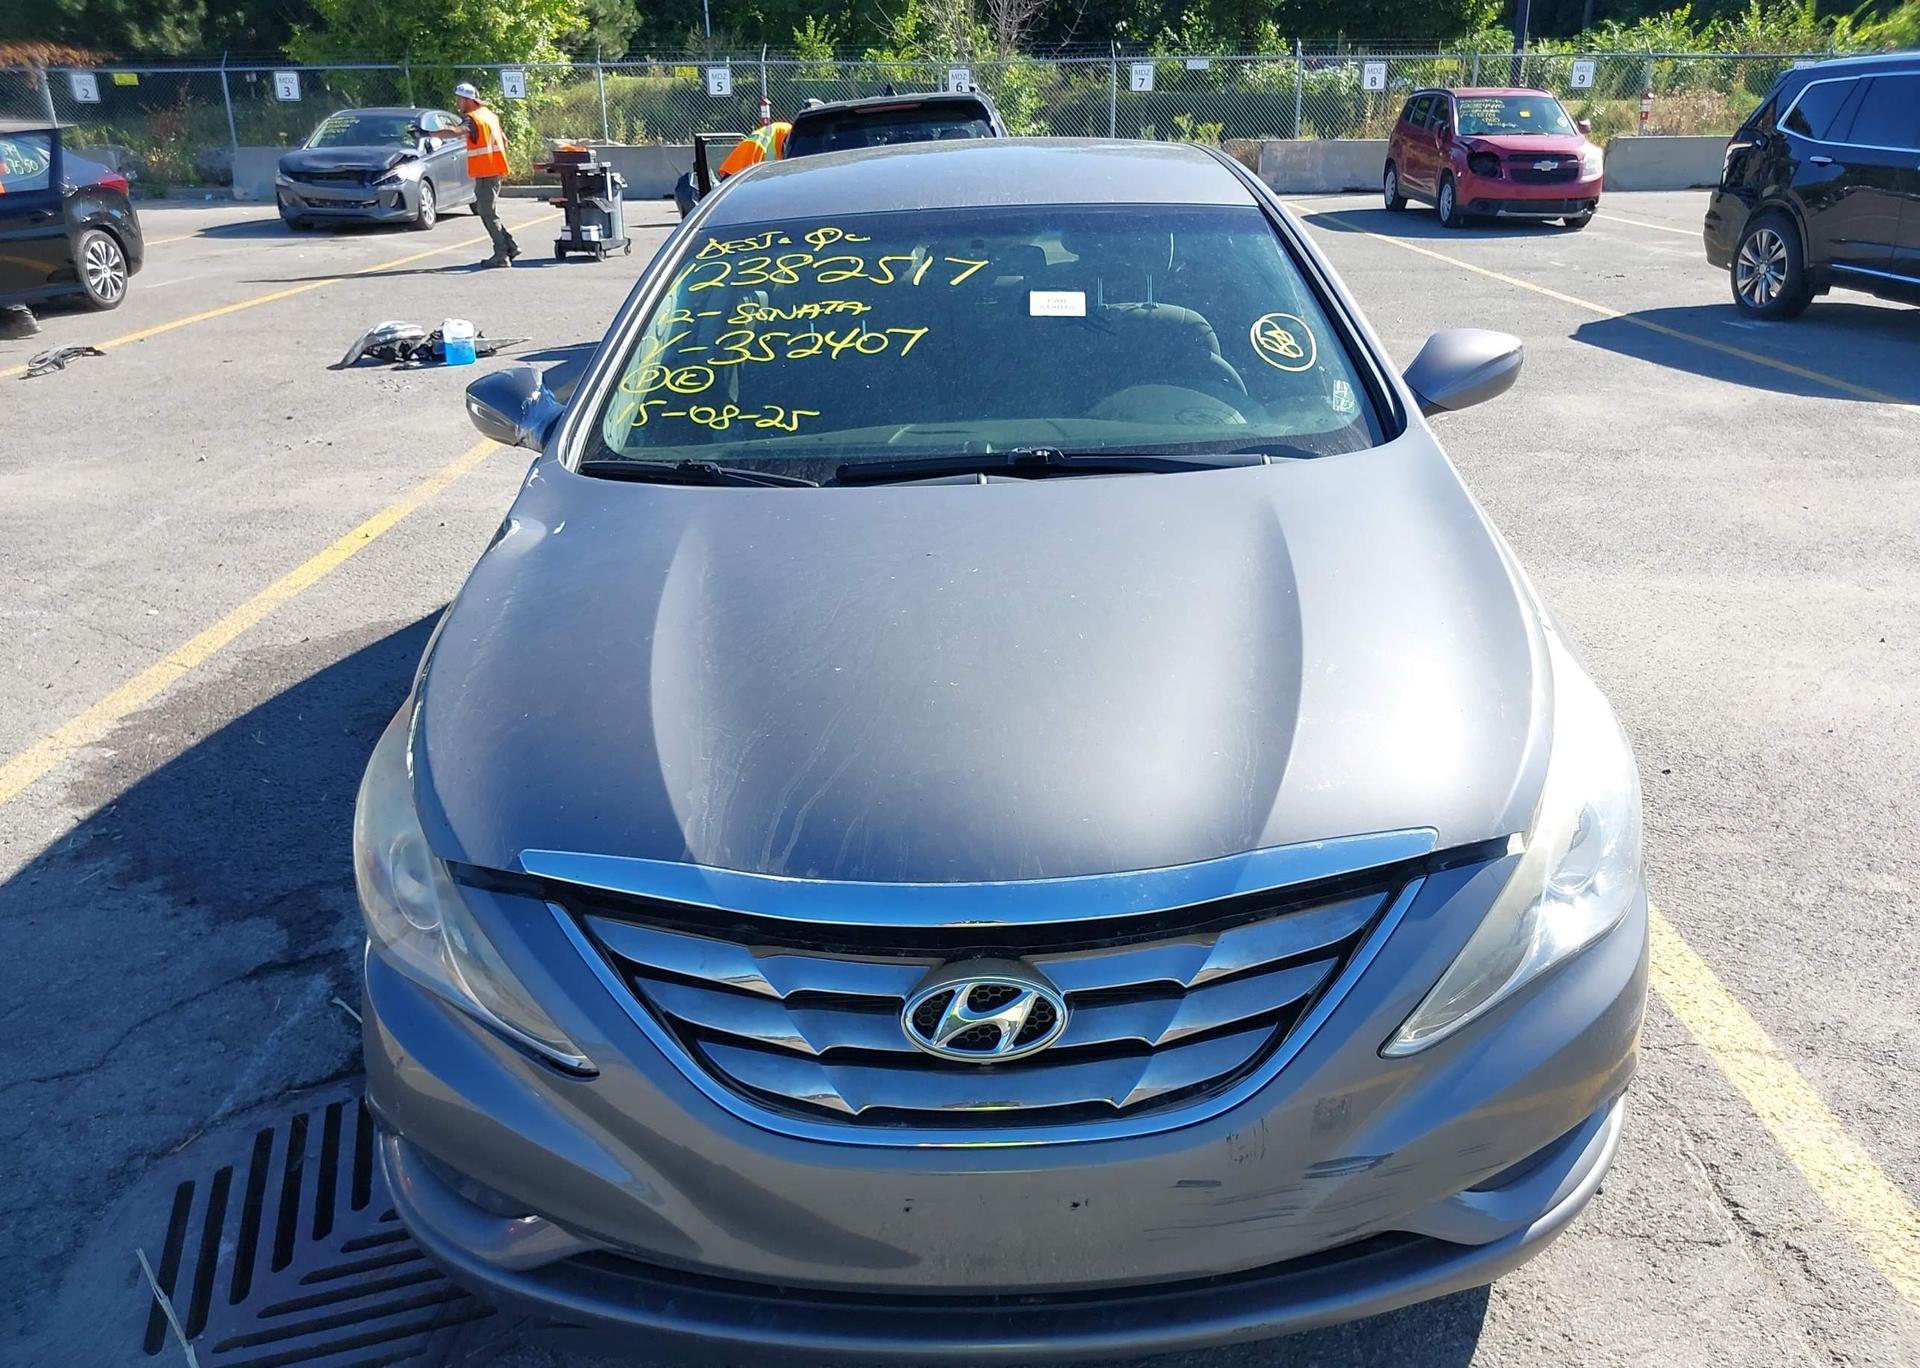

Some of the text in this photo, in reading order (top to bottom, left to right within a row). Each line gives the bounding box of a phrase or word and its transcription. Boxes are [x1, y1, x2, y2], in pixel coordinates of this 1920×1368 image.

[1138, 78, 1145, 88] 7
[1370, 76, 1377, 87] 8
[1578, 74, 1585, 84] 9
[284, 86, 291, 97] 3
[510, 84, 518, 95] 4
[716, 82, 723, 92] 5
[956, 82, 963, 92] 6
[82, 88, 90, 99] 2
[667, 253, 989, 295] 12382517
